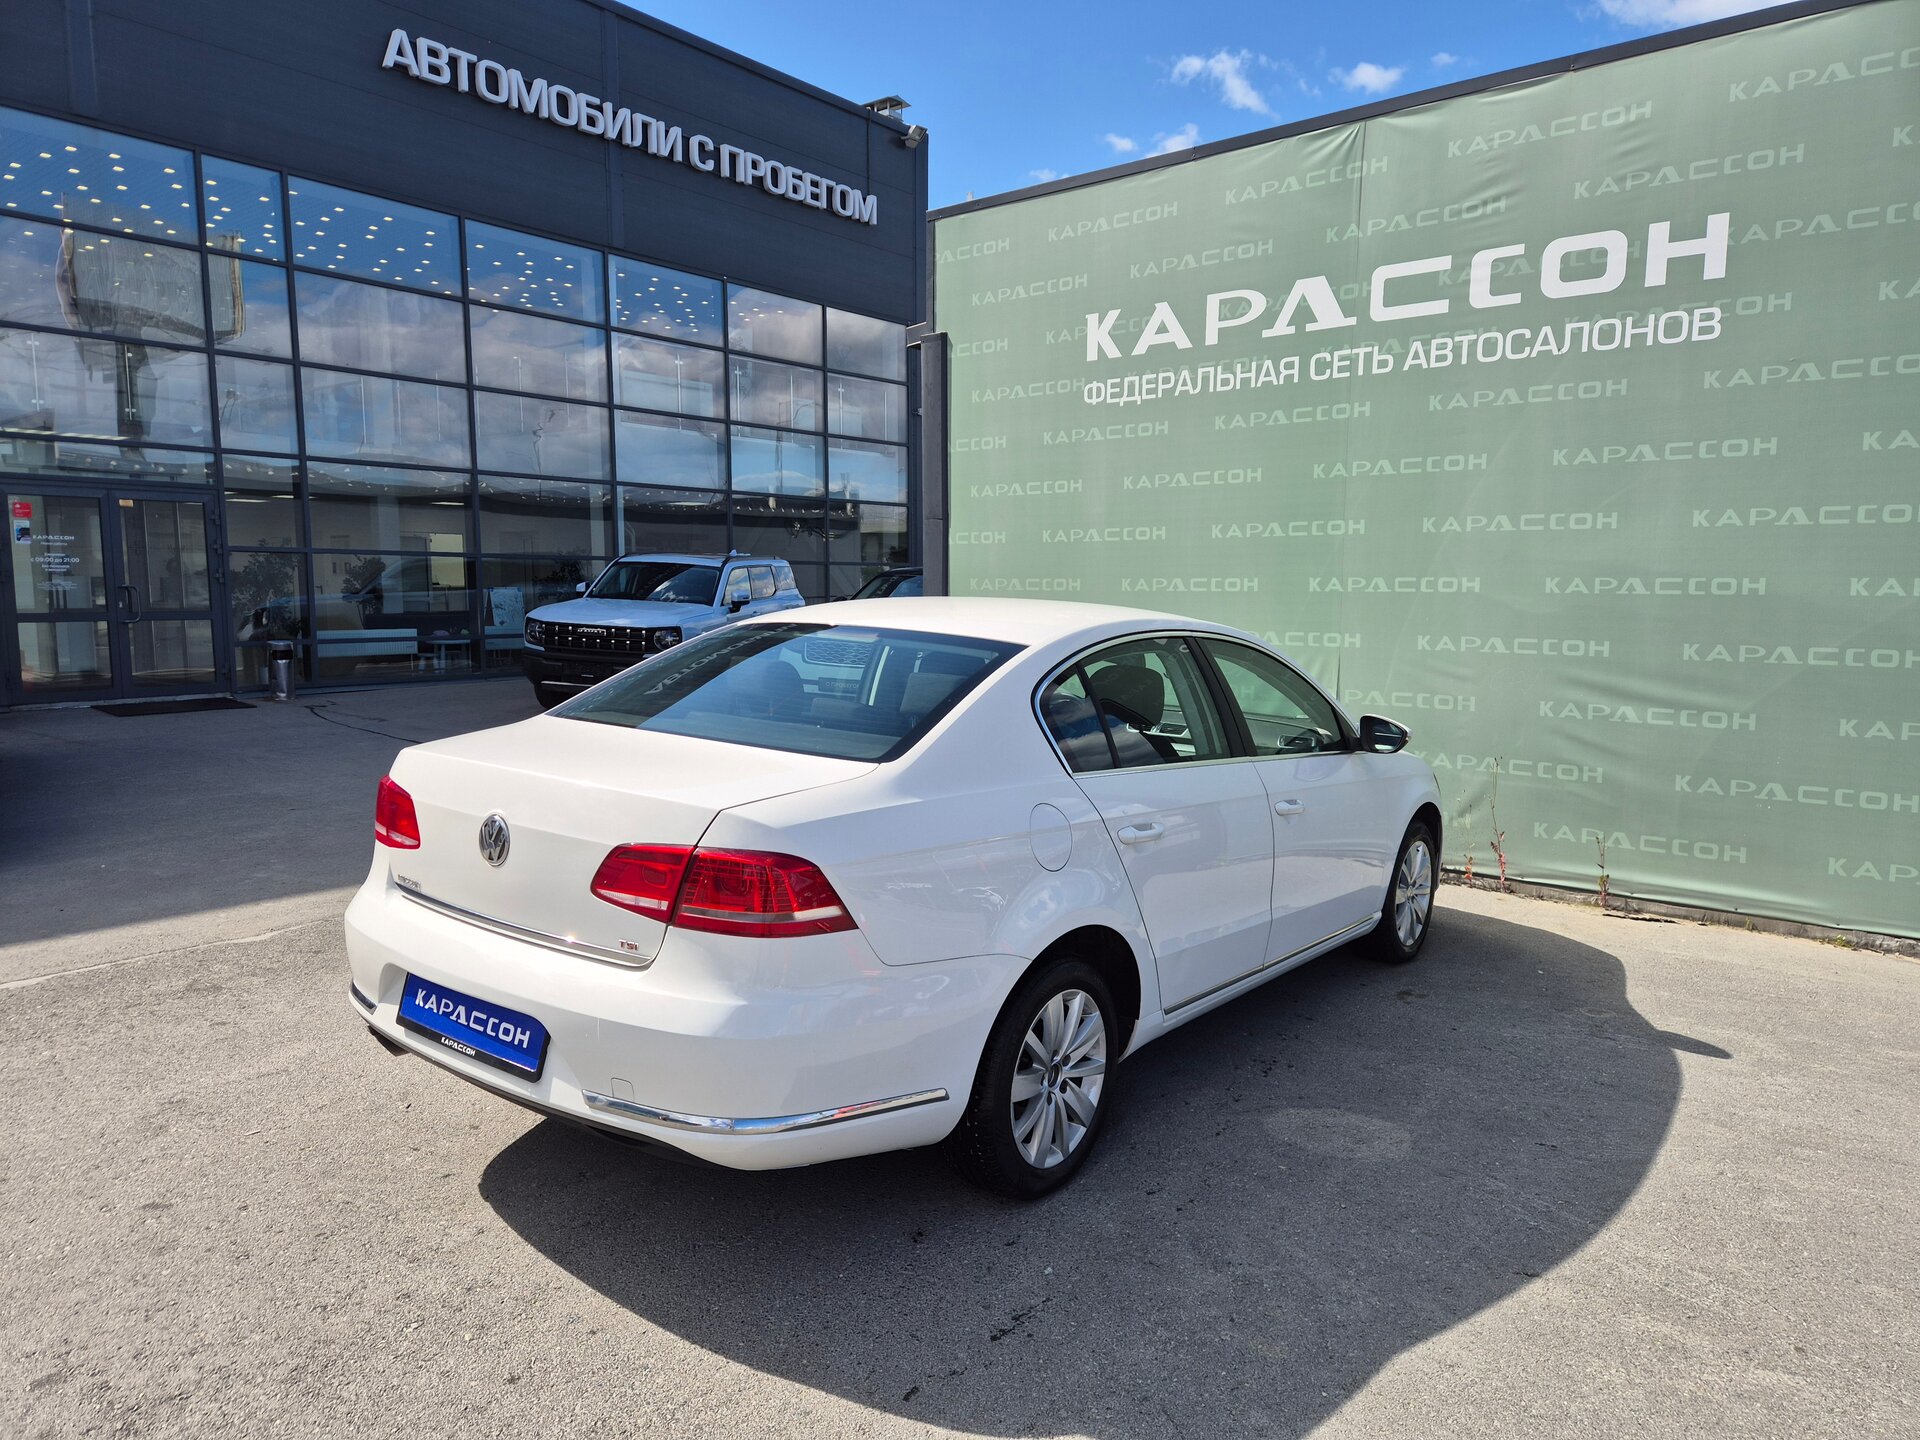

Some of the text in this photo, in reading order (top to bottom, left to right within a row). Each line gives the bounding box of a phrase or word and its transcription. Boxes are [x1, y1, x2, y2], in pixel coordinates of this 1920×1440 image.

[382, 28, 878, 225] АВТОМОБИЛИ С ПРОБЕГОМ
[1448, 100, 1653, 158] КАРАССОН
[1225, 156, 1387, 205] КАРАССОН
[1574, 144, 1805, 199] КАРАССОН
[1048, 202, 1178, 242] КАРАССОН
[1326, 196, 1506, 243] КАРАССОН
[1130, 239, 1273, 279] КАРАССОН
[972, 273, 1088, 306] КАРАССОН
[1086, 212, 1730, 362] КАРАССОН
[1084, 307, 1722, 407] ФЕДЕРАЛЬНАЯ СЕТЬ АВТОСАЛОНОВ
[972, 377, 1085, 403] КАРАССОН
[1429, 378, 1628, 411] КАРАССОН
[1215, 401, 1371, 430] КАРАССОН
[1043, 420, 1169, 445] КАРАССОН
[1313, 453, 1487, 479] КАРАССОН
[1553, 437, 1778, 466] КАРАССОН
[970, 479, 1083, 498] КАРАССОН
[1123, 467, 1262, 490] КАРАССОН
[1211, 519, 1365, 539] КАРАССОН
[1422, 512, 1618, 533] КАРАССОН
[1692, 504, 1920, 528] КАРАССО
[1042, 526, 1166, 543] КАРАССОН
[970, 577, 1081, 591] КАРАССОН
[1121, 577, 1259, 592] КАРАССОН
[1309, 577, 1480, 593] КАРАССОН
[1545, 577, 1767, 595] КАРАССОН
[1417, 635, 1610, 658] КАРАССОН
[1539, 701, 1756, 731] КАРАССОН
[1675, 774, 1919, 814] КАРАССОН
[1534, 822, 1746, 864] КАРАССОН
[619, 939, 639, 951] TSI
[415, 988, 531, 1049] КАРАССОН
[441, 1037, 476, 1057] КАРАССОН
